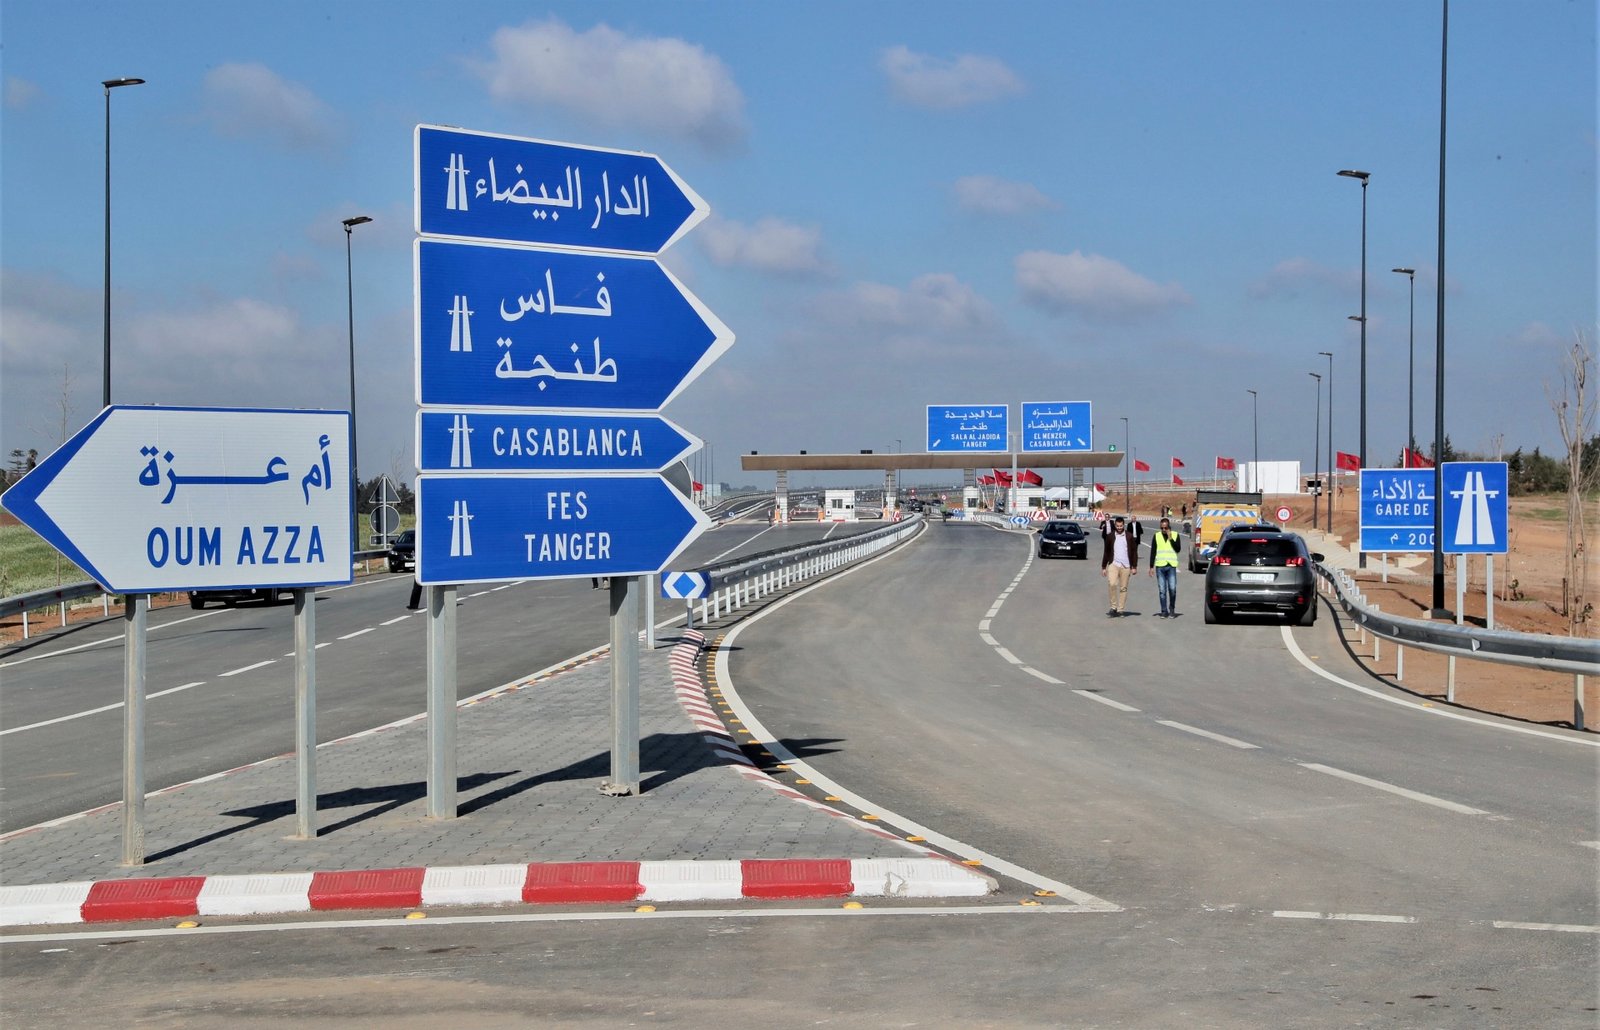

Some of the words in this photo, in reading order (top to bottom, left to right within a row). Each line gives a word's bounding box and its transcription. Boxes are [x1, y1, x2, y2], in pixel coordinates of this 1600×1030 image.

[475, 157, 583, 221] البيضاء
[592, 171, 650, 229] الدار
[500, 268, 612, 322] فاس
[495, 336, 618, 391] طنجة
[960, 421, 988, 432] طنجة
[986, 410, 1003, 418] سلا
[1027, 419, 1058, 431] البيضاء
[1057, 419, 1073, 431] الدار
[492, 427, 643, 457] CASABLANCA
[1029, 440, 1071, 448] CASABLANCA
[1033, 432, 1041, 440] EL
[139, 445, 289, 504] عزة
[302, 434, 332, 505] أم
[1372, 477, 1413, 499] الأداء
[547, 491, 588, 520] FES
[1375, 503, 1410, 516] GARE
[1414, 503, 1430, 516] DE
[147, 526, 221, 568] OUM
[236, 525, 325, 565] AZZA
[524, 532, 611, 562] TANGER
